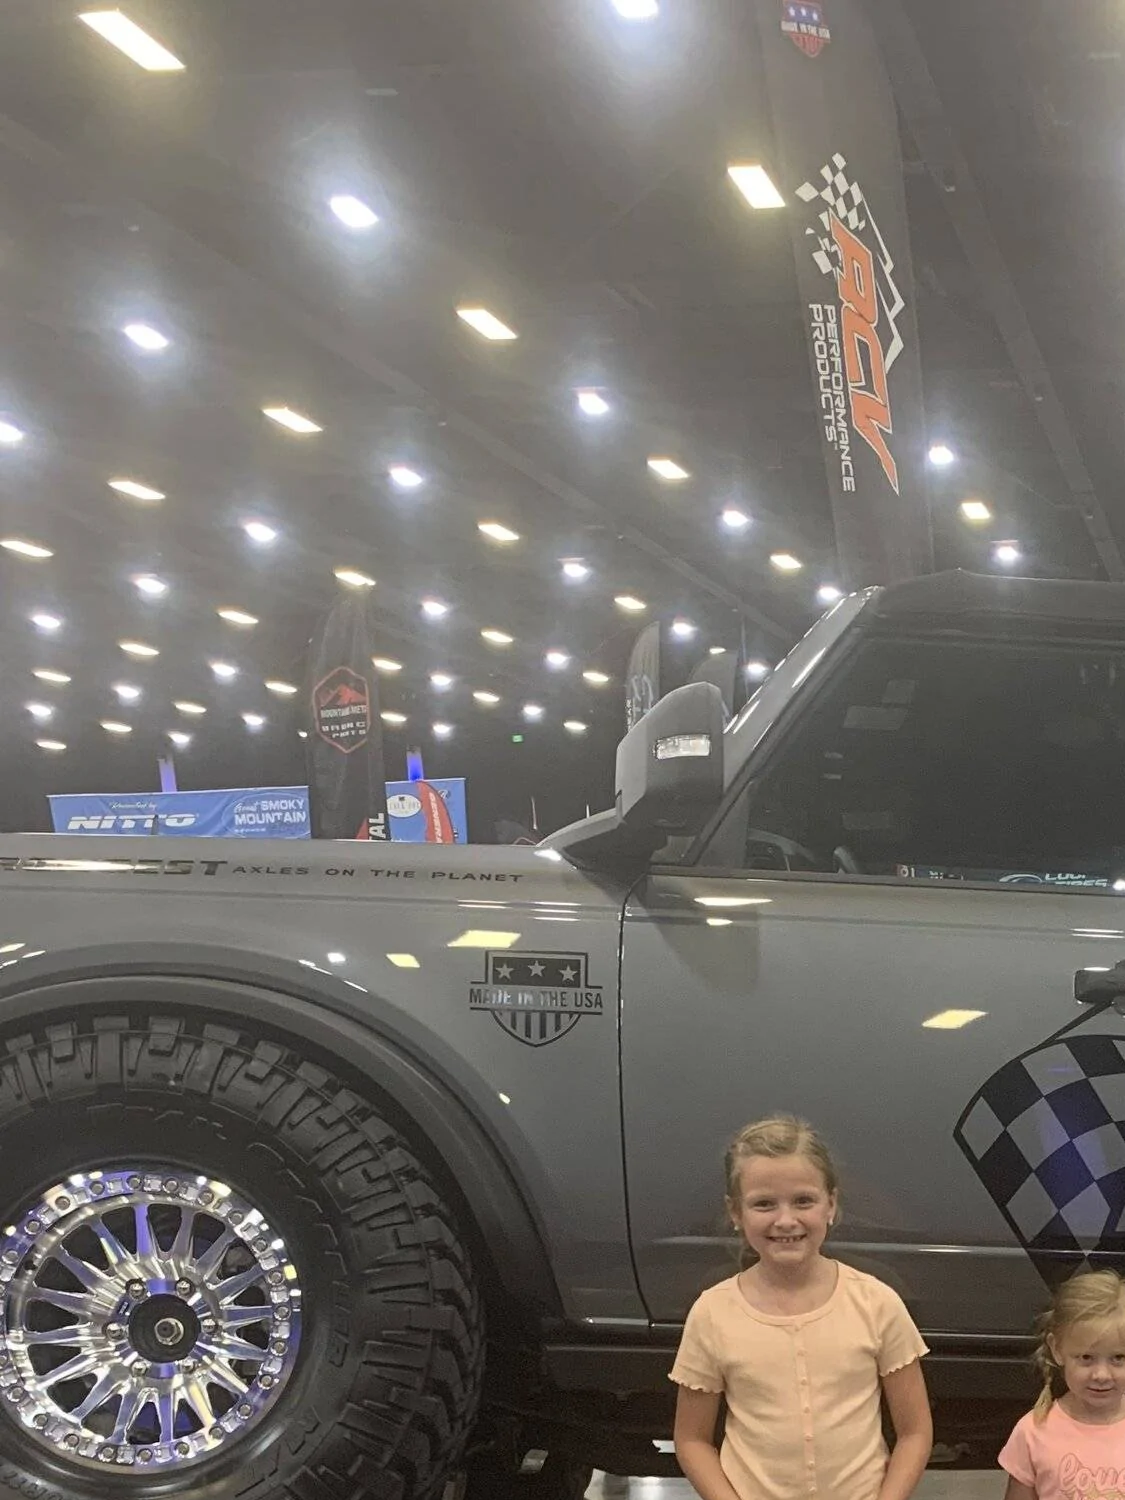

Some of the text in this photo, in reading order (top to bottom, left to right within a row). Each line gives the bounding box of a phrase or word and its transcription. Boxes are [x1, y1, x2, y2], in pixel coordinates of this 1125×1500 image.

[829, 207, 899, 496] RCV
[808, 303, 837, 442] PRODUCTS
[823, 304, 856, 493] PERFORMANCE
[260, 799, 304, 811] SMOKY
[67, 813, 196, 830] NITTO
[235, 811, 307, 826] MOUNTAIN
[232, 866, 309, 875] AXLES
[325, 868, 355, 877] ON
[370, 869, 415, 878] THE
[432, 871, 524, 882] PLANET
[540, 990, 567, 1007] THE
[574, 992, 603, 1009] USA
